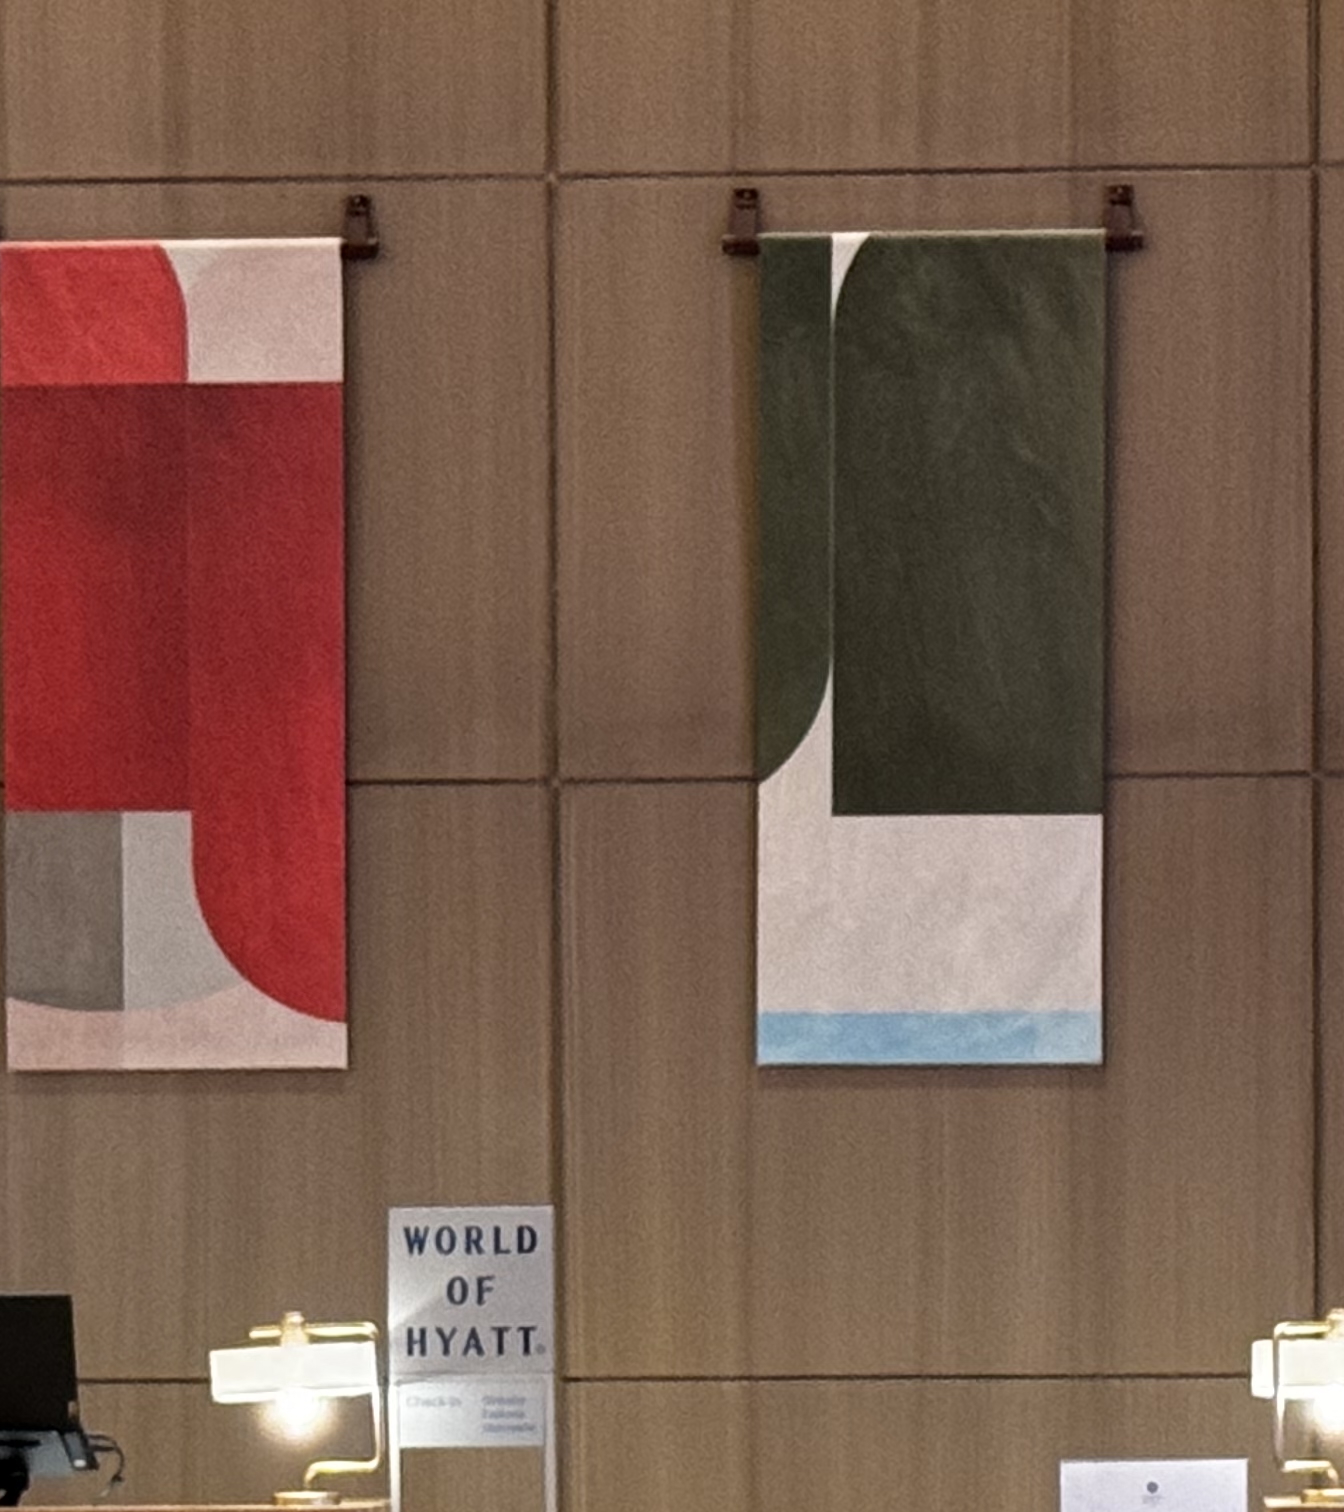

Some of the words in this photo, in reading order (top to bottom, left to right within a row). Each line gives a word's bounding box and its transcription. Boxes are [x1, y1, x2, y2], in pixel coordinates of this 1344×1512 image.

[403, 1225, 538, 1255] WORLD
[446, 1275, 495, 1306] OF
[406, 1325, 537, 1356] HYATT
